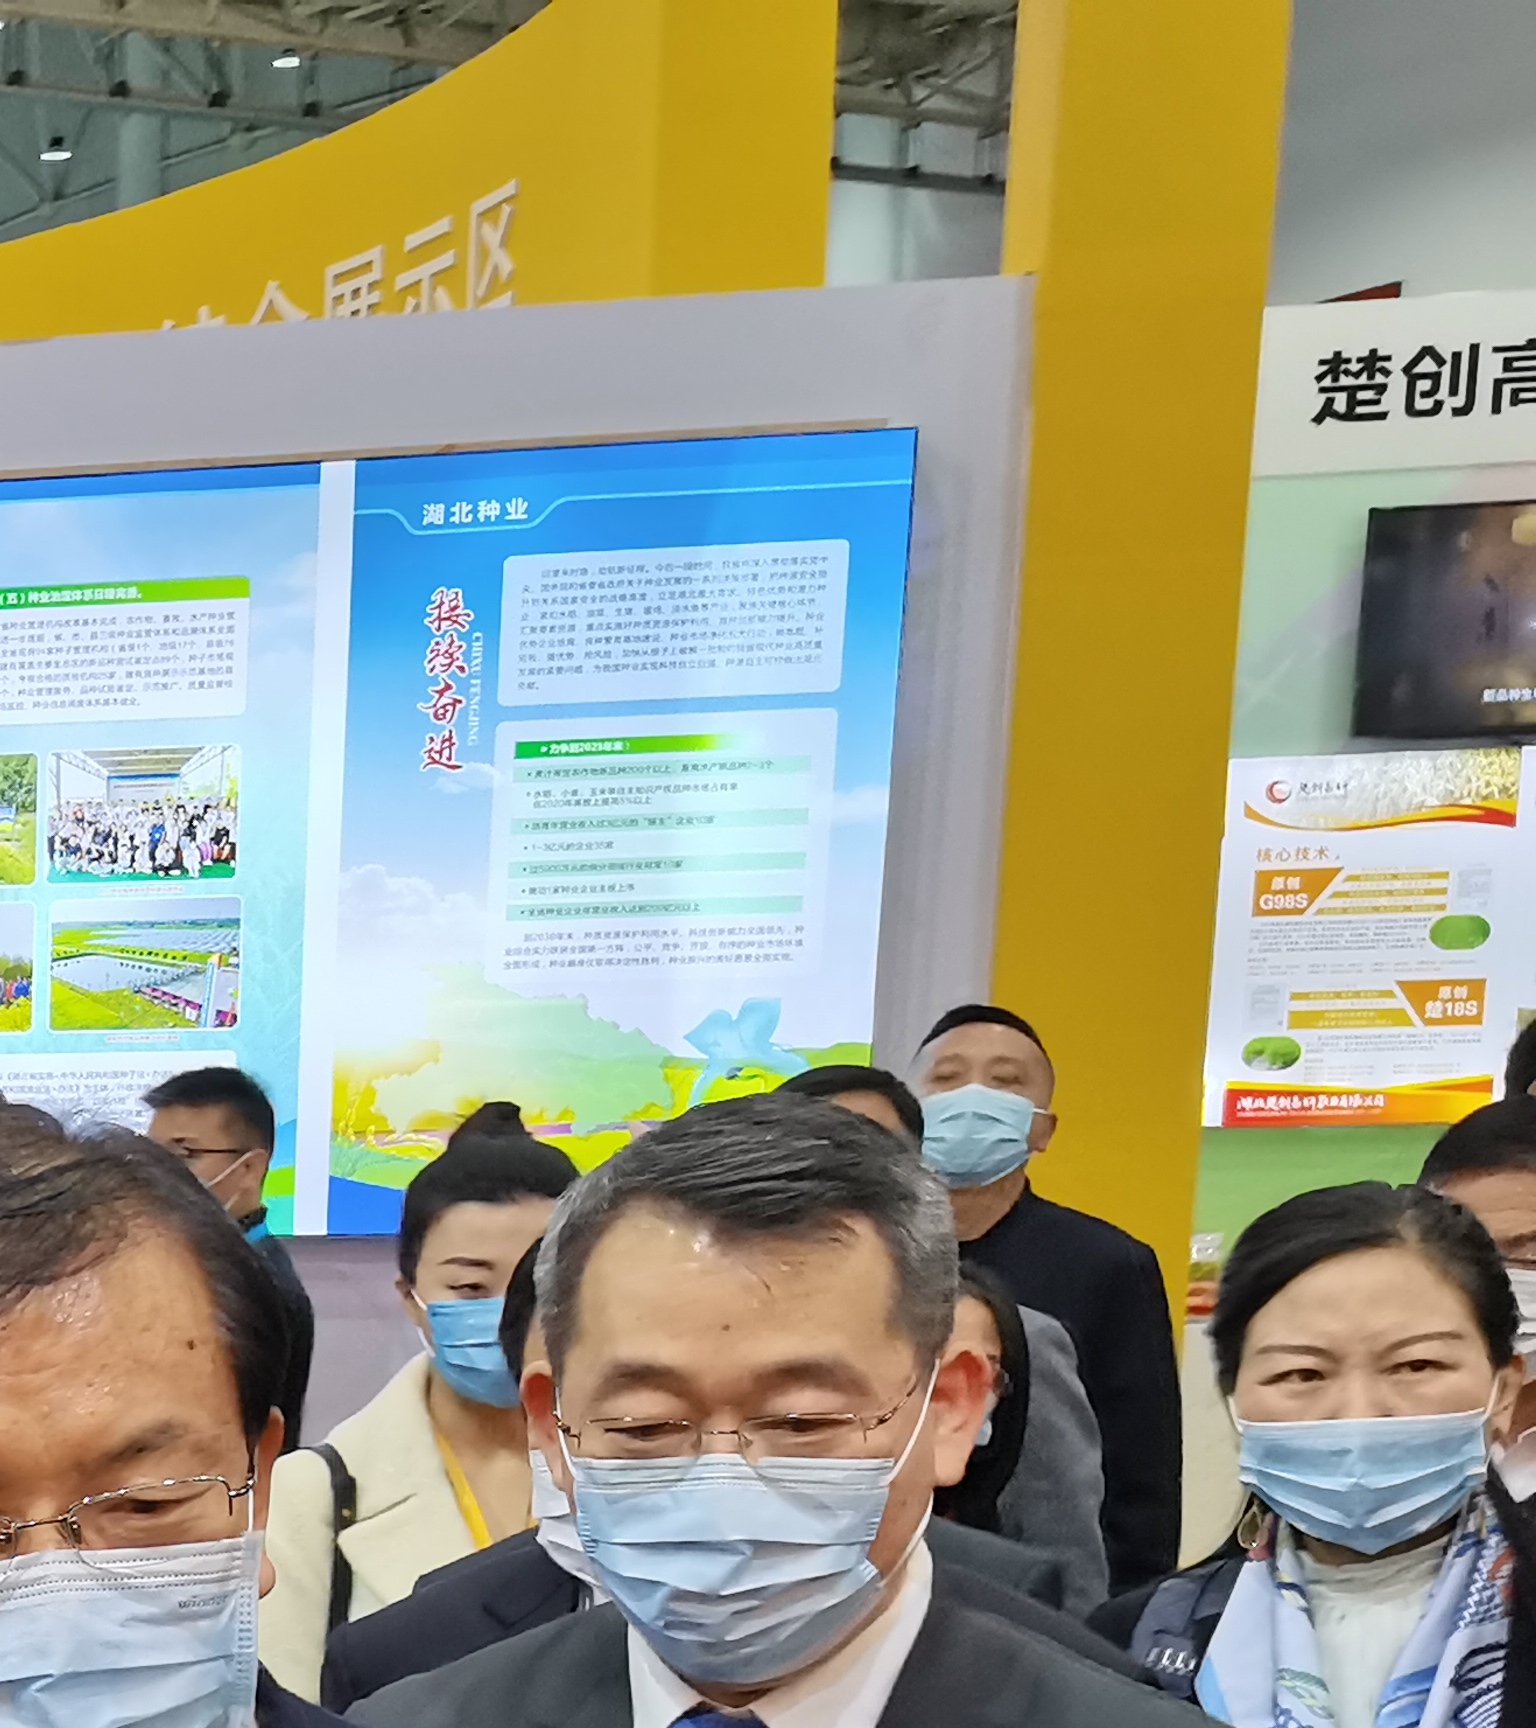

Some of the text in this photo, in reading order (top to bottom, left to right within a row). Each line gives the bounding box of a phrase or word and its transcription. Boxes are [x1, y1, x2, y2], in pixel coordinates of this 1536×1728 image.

[159, 178, 520, 330] 展示区
[422, 497, 530, 527] 湖北种业
[417, 587, 474, 772] 接续奋进
